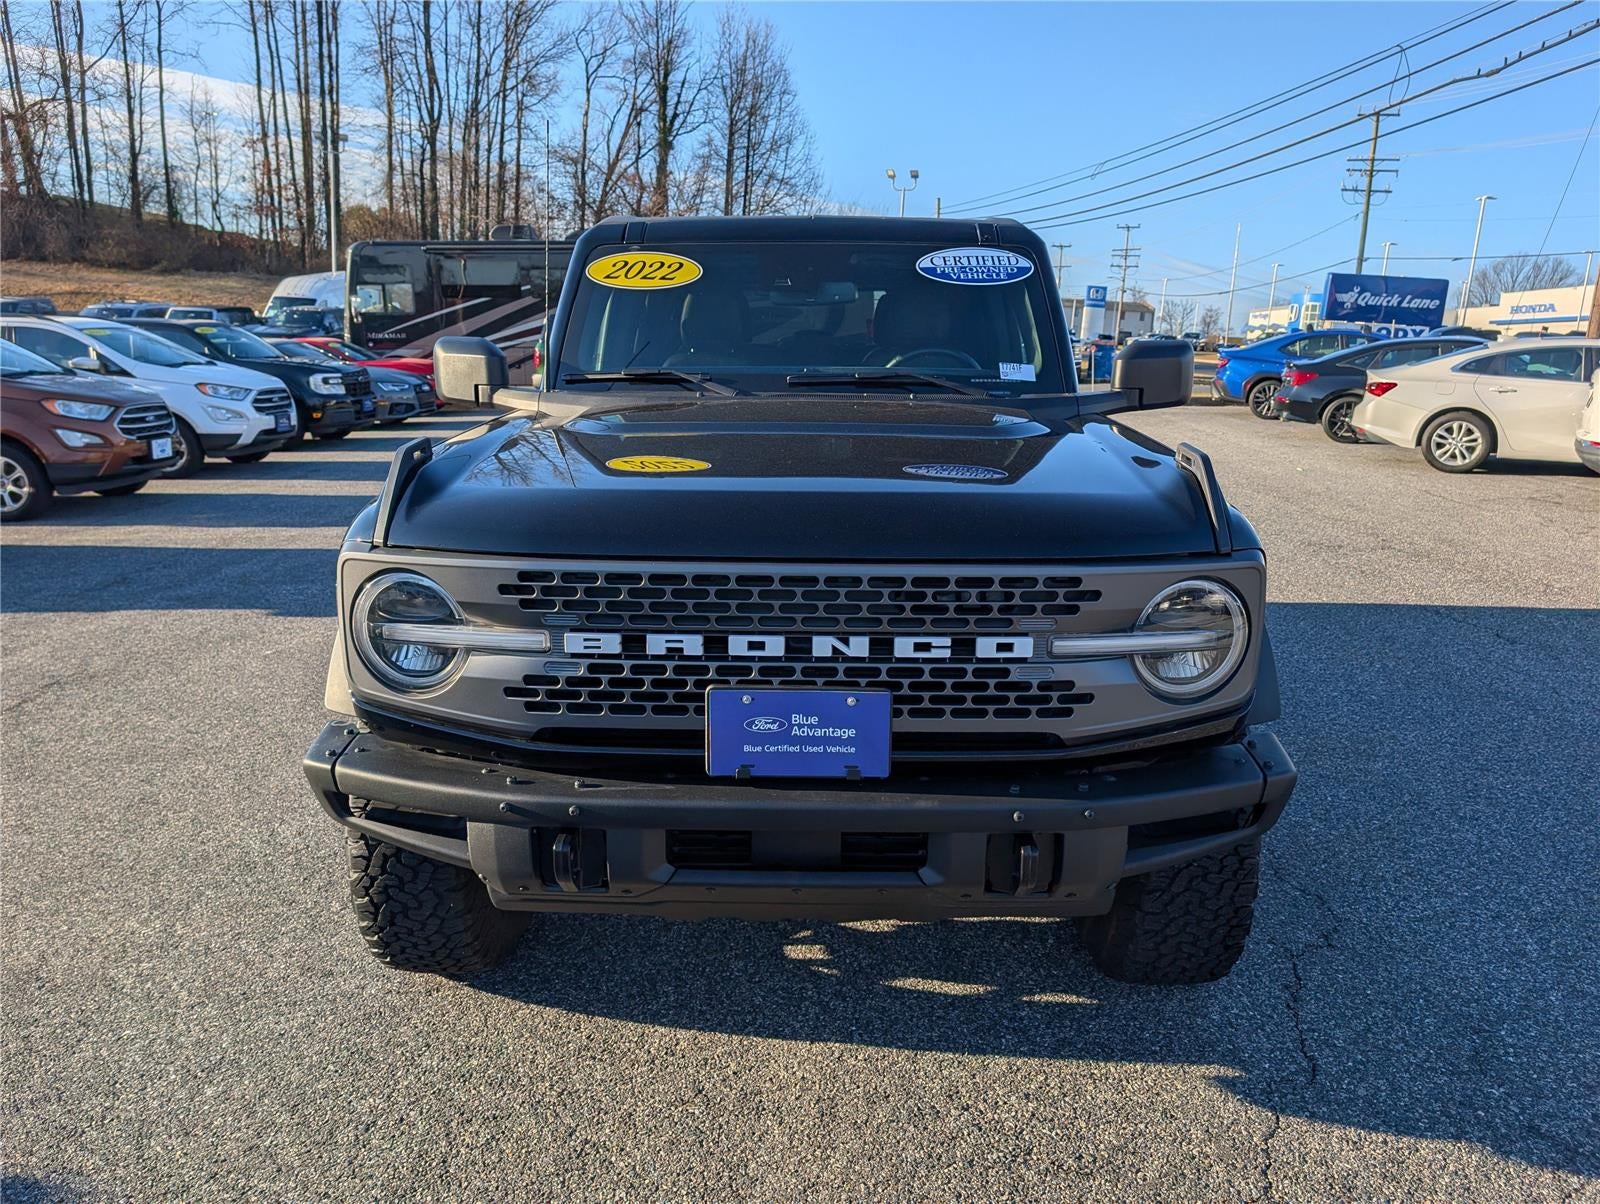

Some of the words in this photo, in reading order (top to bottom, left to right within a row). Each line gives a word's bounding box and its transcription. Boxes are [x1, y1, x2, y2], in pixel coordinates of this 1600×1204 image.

[930, 255, 1019, 266] CERTIFIED
[603, 260, 684, 280] 2022
[1357, 292, 1402, 307] Quick
[1400, 295, 1440, 309] Lane
[1510, 303, 1557, 314] HONDA
[564, 632, 1034, 658] BRONCO
[752, 718, 779, 731] Ford
[791, 713, 819, 725] Blue
[791, 726, 856, 739] Advantage
[743, 744, 762, 752] Blue
[765, 744, 800, 753] Certified
[802, 745, 824, 753] Used
[826, 745, 856, 753] Vehicle
